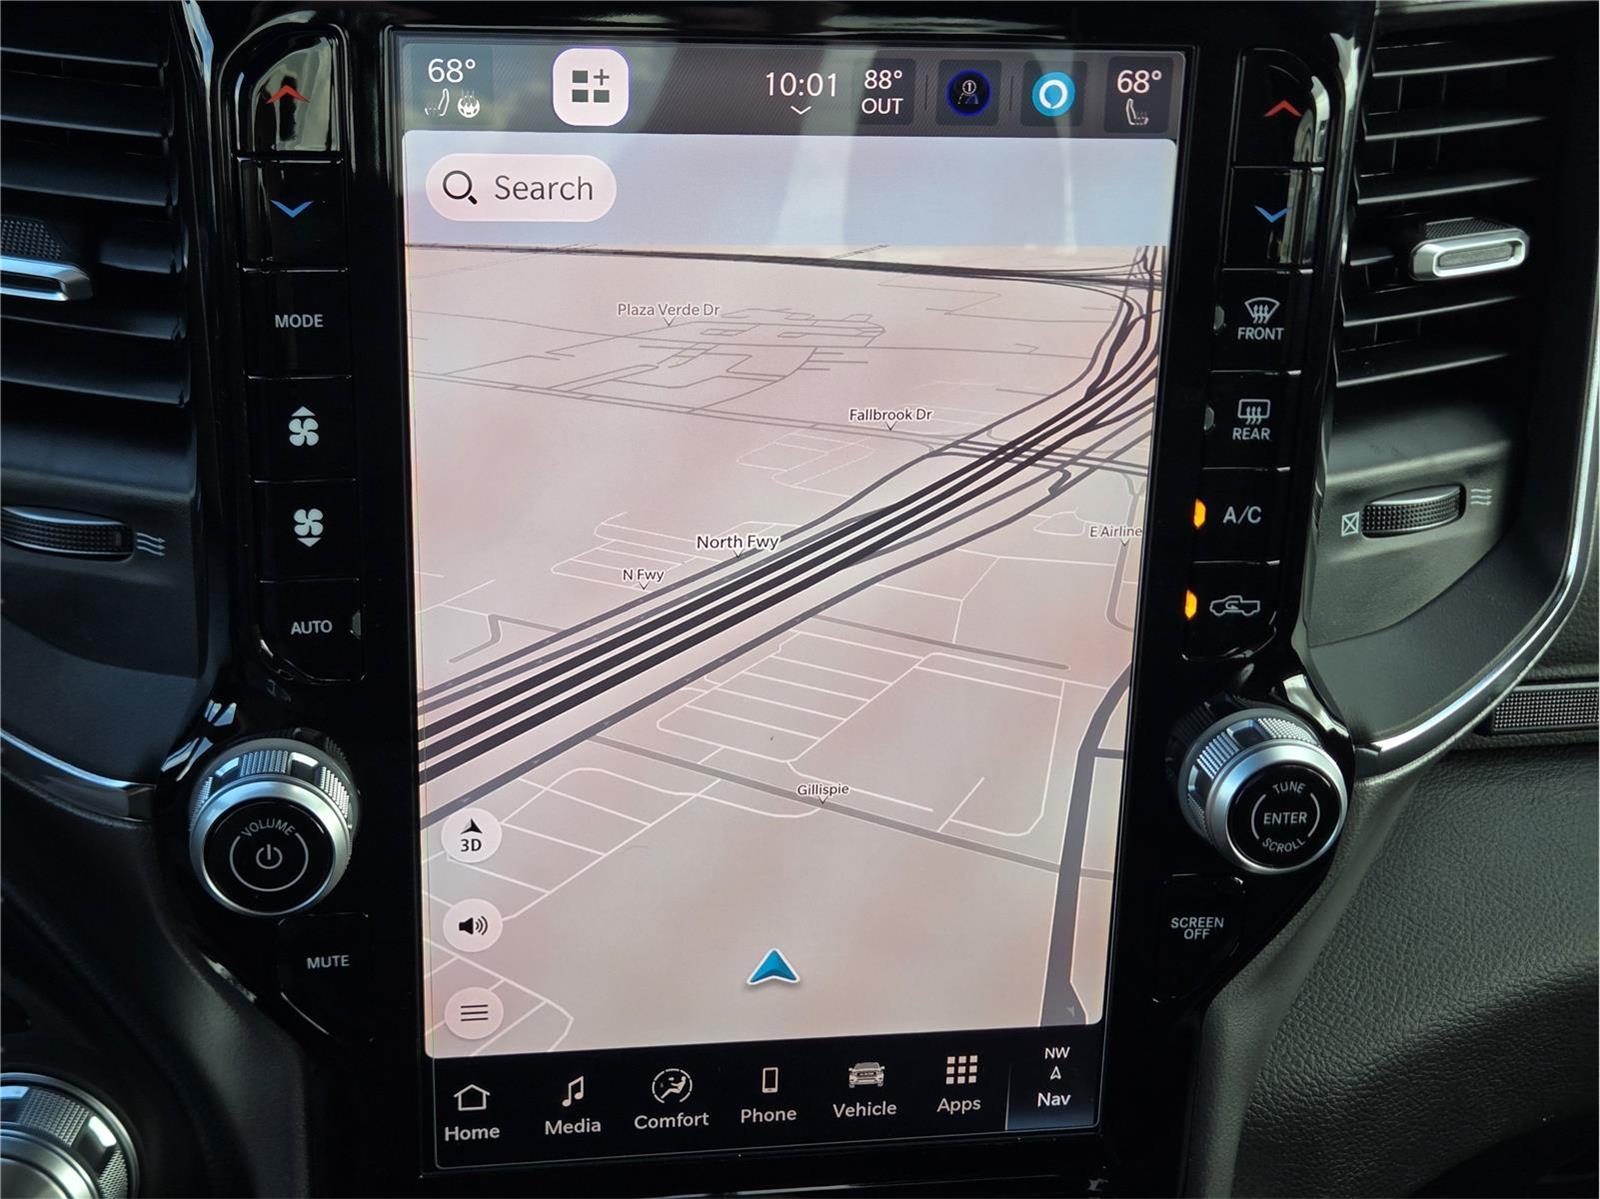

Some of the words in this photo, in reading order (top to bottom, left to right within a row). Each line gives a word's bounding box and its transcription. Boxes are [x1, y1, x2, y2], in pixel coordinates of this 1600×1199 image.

[427, 57, 476, 83] 68°
[765, 72, 838, 97] 10:01
[864, 69, 903, 90] 88°
[1116, 69, 1162, 93] 68°
[861, 98, 903, 115] OUT
[494, 174, 594, 201] Search
[617, 302, 654, 316] Plaza
[657, 302, 700, 316] Verde
[702, 302, 720, 316] Dr
[274, 313, 324, 329] MODE
[1237, 326, 1284, 341] FRONT
[849, 407, 913, 421] Fallbrook
[917, 408, 932, 422] Dr
[1232, 427, 1271, 441] REAR
[1223, 506, 1262, 524] A/C
[1090, 525, 1098, 538] E
[1100, 524, 1143, 537] Airline
[696, 533, 743, 550] North
[746, 534, 780, 552] Fwy
[622, 568, 635, 582] N
[637, 568, 664, 584] Fwy
[290, 620, 333, 635] AUTO
[797, 781, 850, 798] Gillispie
[1272, 781, 1306, 795] TUNE
[1263, 810, 1308, 826] ENTER
[240, 817, 296, 838] VOLUME
[459, 838, 482, 852] 3D
[1261, 836, 1306, 854] SCROLL
[1170, 916, 1225, 930] SCREEN
[1183, 926, 1211, 940] OFF
[306, 954, 350, 970] MUTE
[1044, 1046, 1070, 1058] NW
[937, 1095, 982, 1115] Apps
[1036, 1091, 1071, 1107] Nav
[739, 1106, 797, 1124] Phone
[832, 1100, 898, 1119] Vehicle
[544, 1117, 601, 1136] Media
[633, 1111, 710, 1130] Comfort
[444, 1123, 500, 1142] Home
